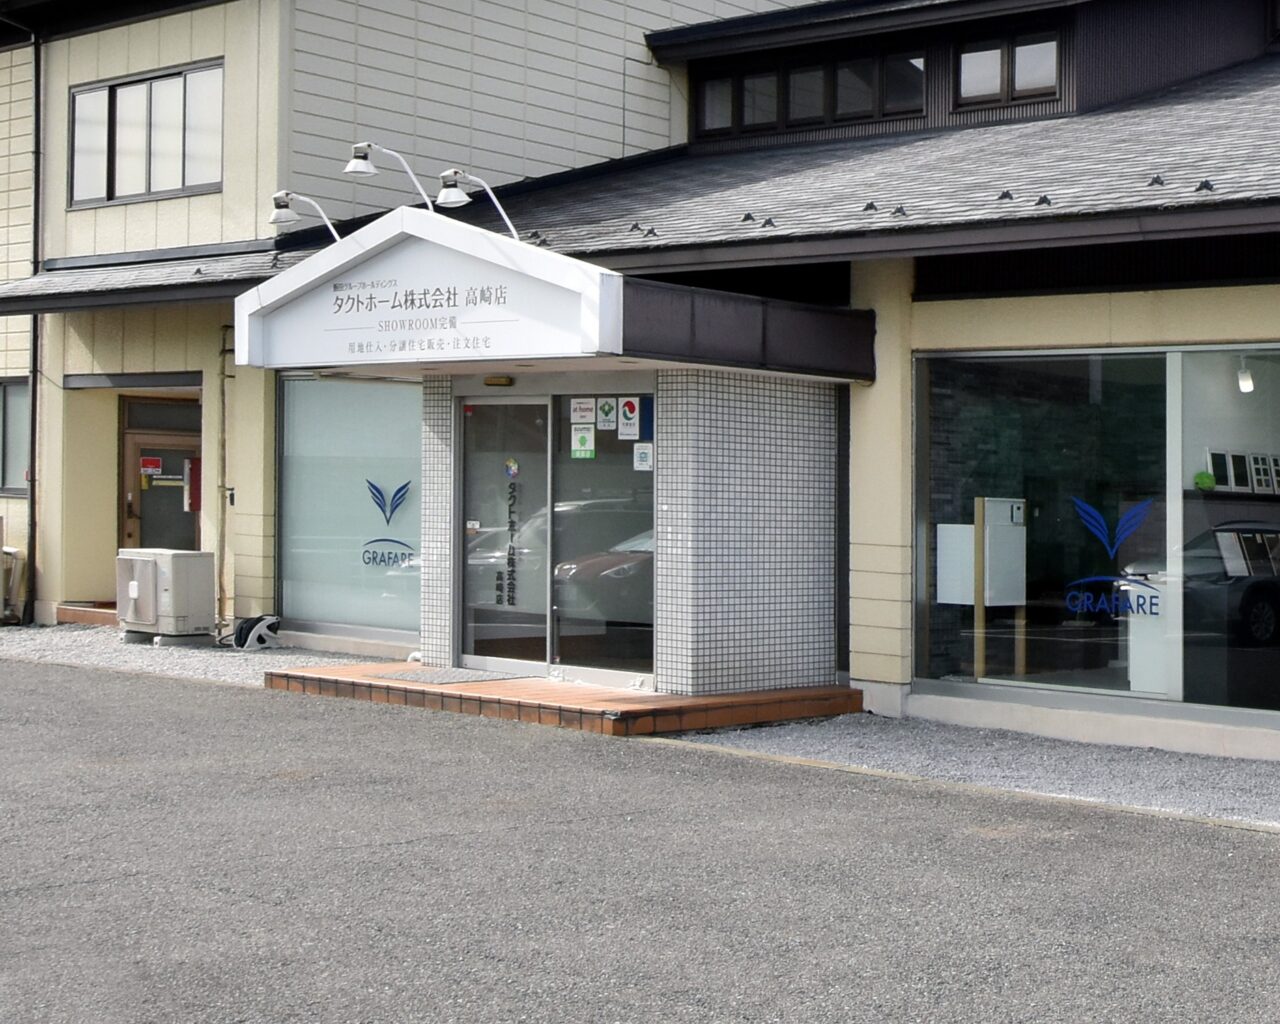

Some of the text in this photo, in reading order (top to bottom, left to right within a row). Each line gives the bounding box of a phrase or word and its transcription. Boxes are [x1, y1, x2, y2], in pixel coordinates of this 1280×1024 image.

[333, 284, 508, 314] タクトホーム株式会社 高崎店
[362, 549, 415, 568] GRAFARE
[1066, 591, 1160, 616] GRAFARE
